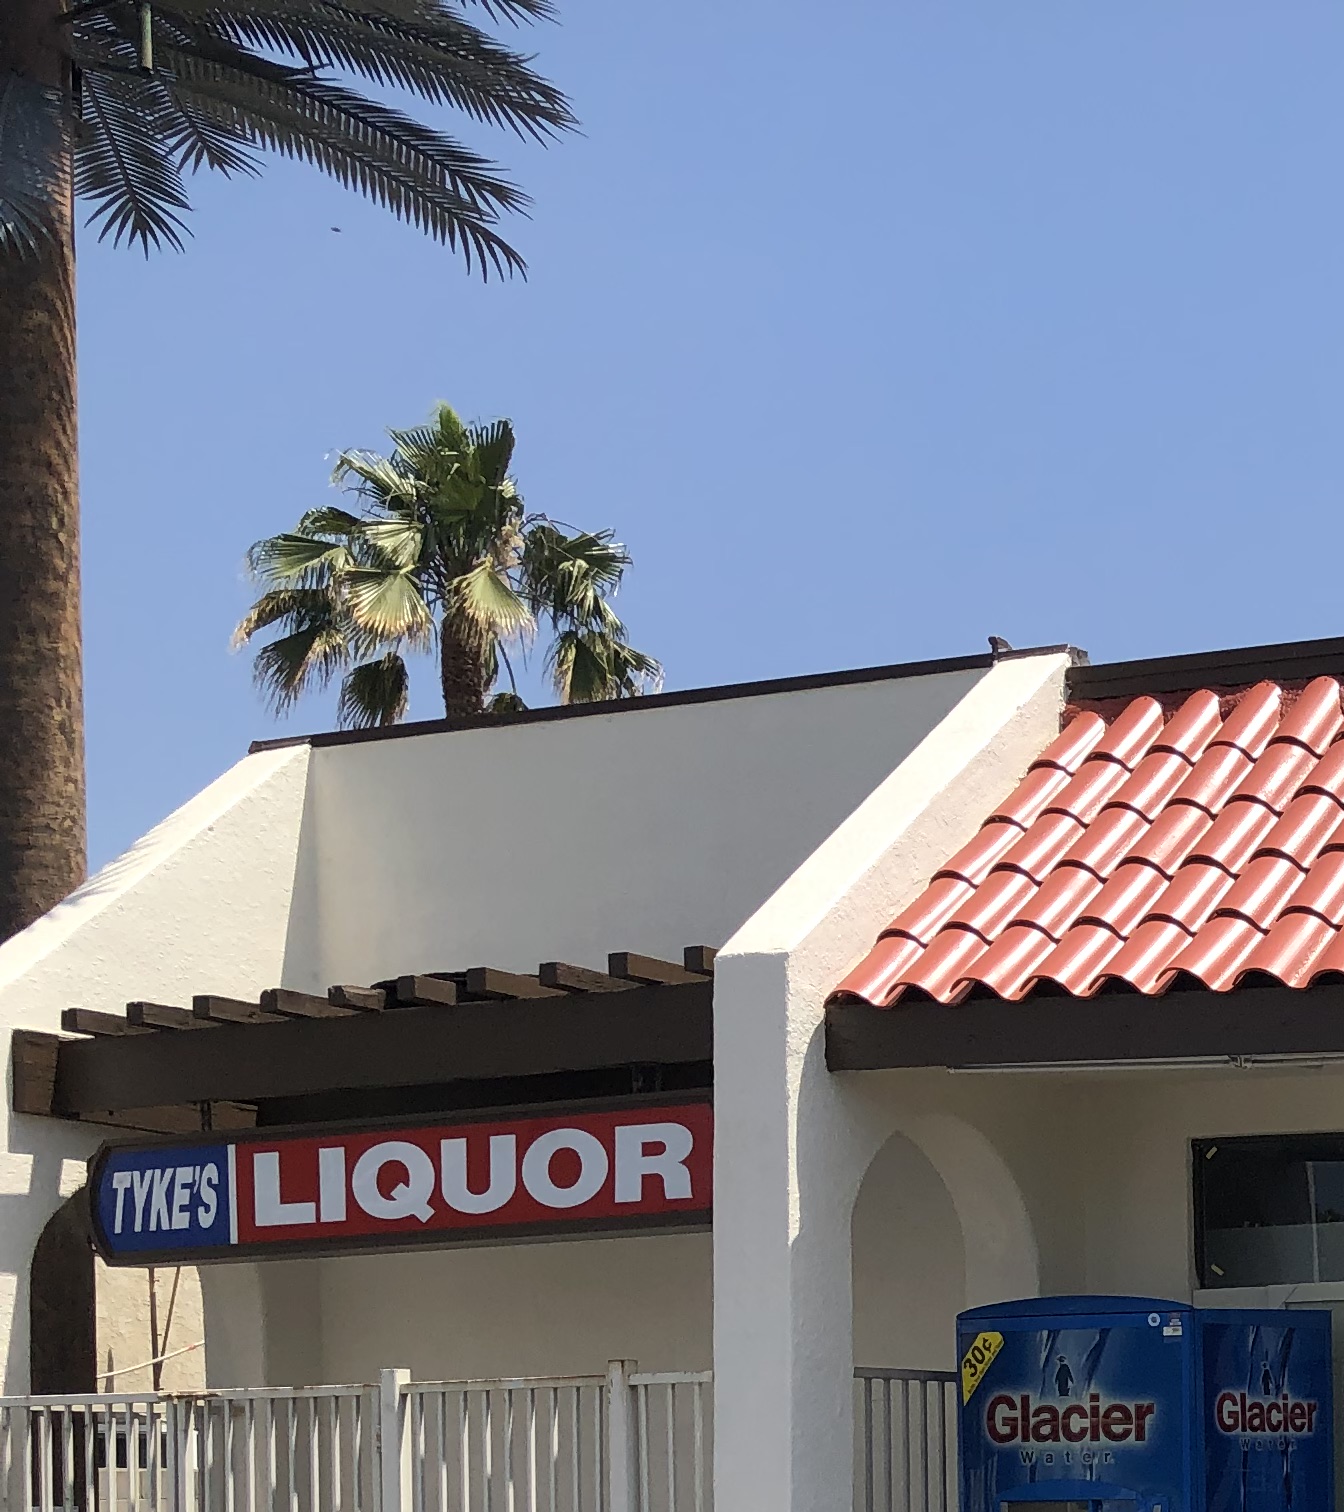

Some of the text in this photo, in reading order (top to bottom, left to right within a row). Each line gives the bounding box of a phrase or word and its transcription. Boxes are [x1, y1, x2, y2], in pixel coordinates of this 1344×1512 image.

[253, 1123, 697, 1226] LIQUOR
[112, 1163, 220, 1235] TYKE'S
[963, 1337, 992, 1378] 30¢
[986, 1393, 1155, 1443] Glacier
[1217, 1392, 1317, 1433] Glacier
[1020, 1451, 1114, 1464] Water
